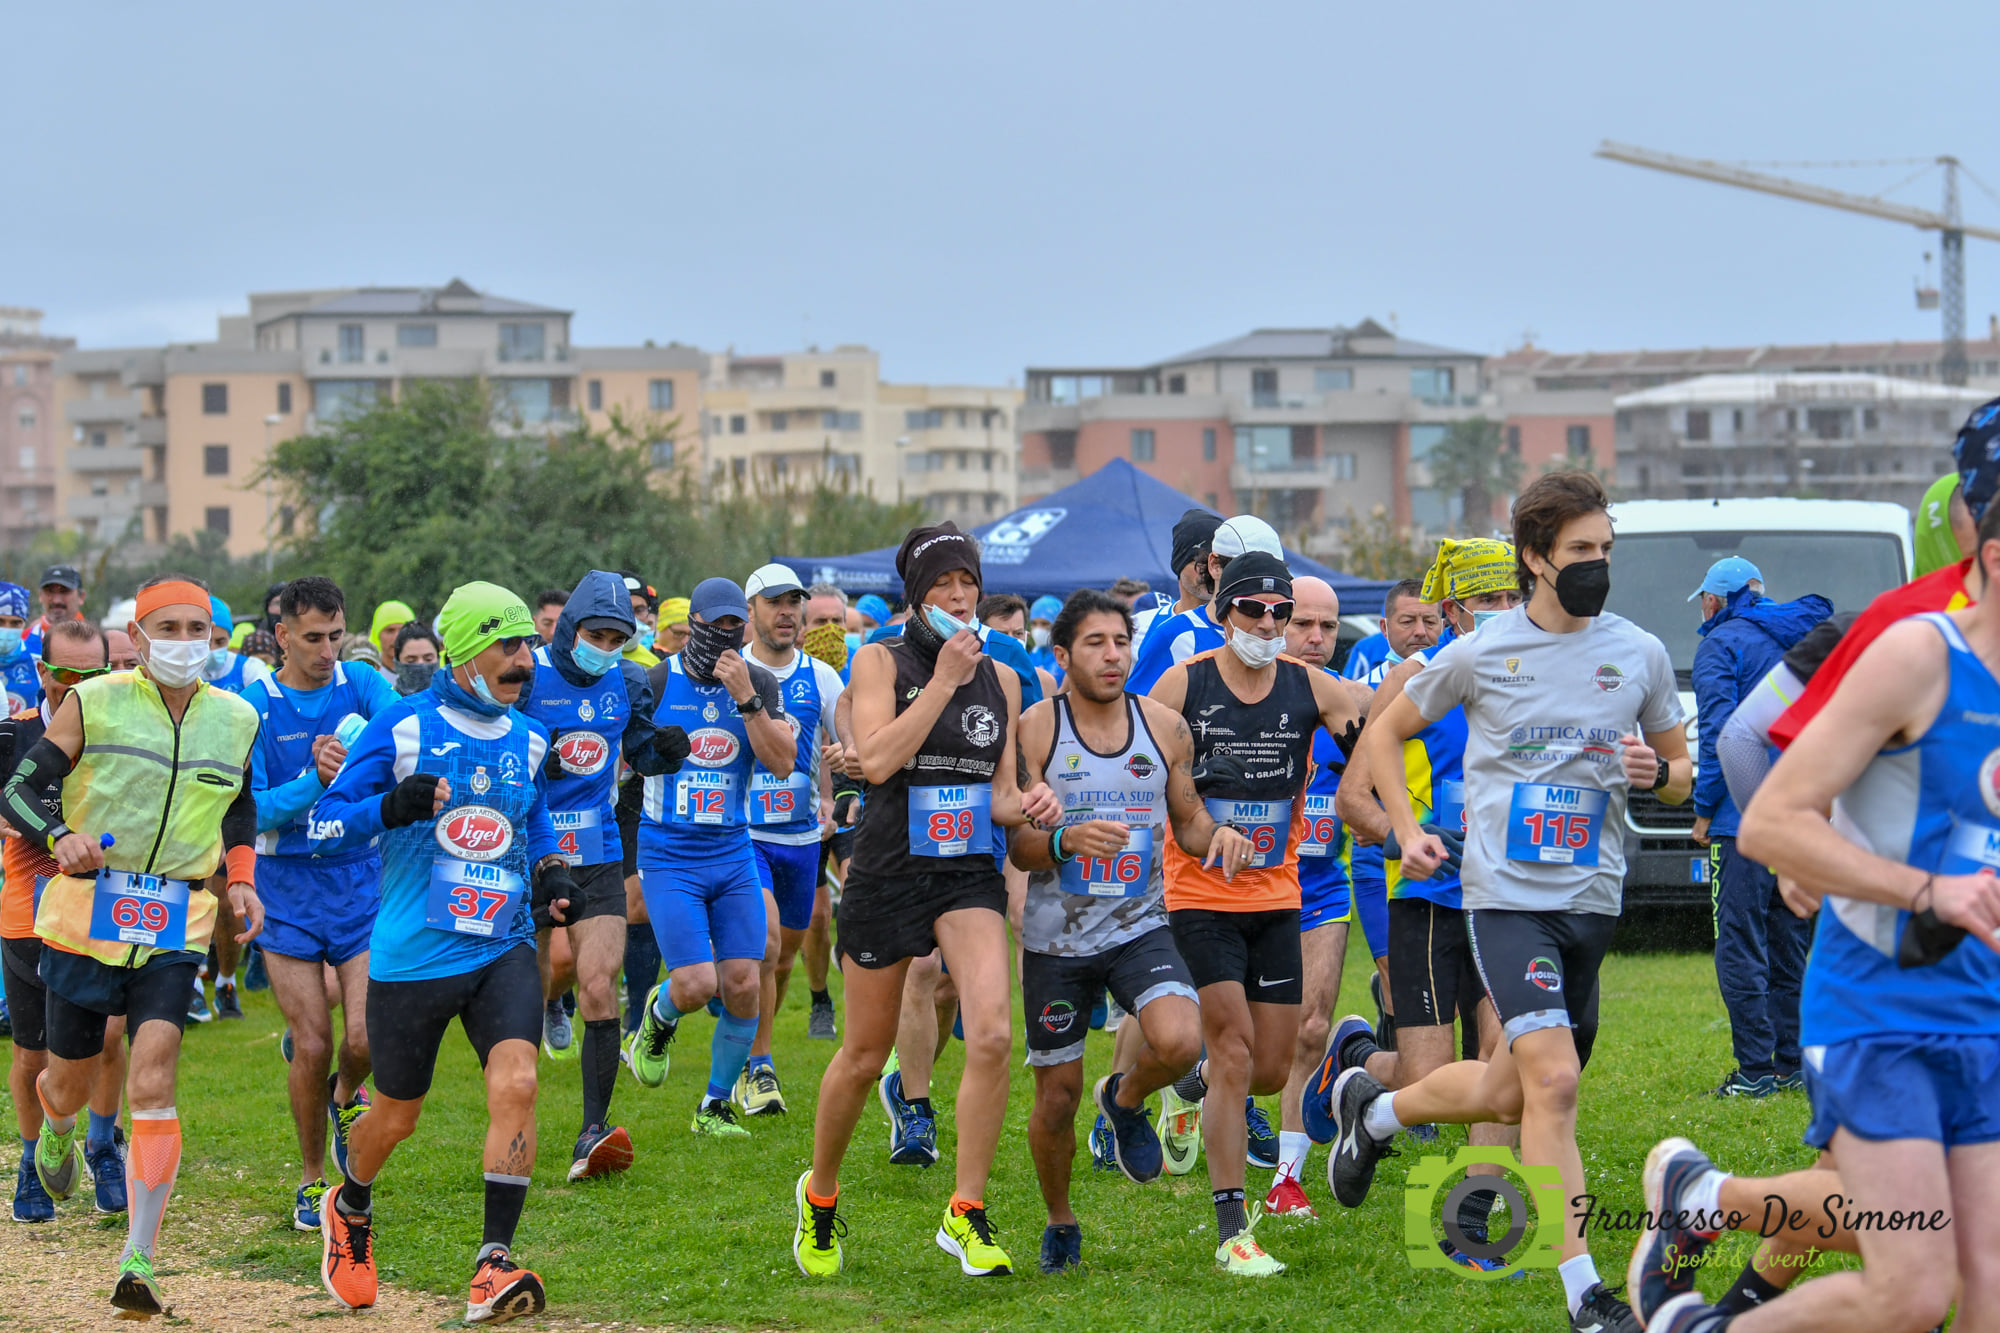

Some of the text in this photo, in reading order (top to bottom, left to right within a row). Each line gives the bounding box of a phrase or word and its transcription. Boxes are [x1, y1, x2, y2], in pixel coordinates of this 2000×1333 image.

[920, 535, 964, 550] GIVOVA
[276, 732, 308, 742] macron
[1530, 726, 1618, 742] ITTICA SUD
[562, 738, 602, 765] Sigel
[692, 734, 730, 758] Sigel
[918, 755, 996, 772] URBAN JUNGLE
[1512, 752, 1558, 761] MAZARA
[1124, 764, 1158, 772] EVOLUTION
[1256, 768, 1286, 778] GRANO
[690, 790, 725, 814] 12
[758, 790, 795, 814] 13
[1080, 791, 1154, 802] ITTICA SUD
[1546, 788, 1581, 804] MBI
[444, 808, 478, 824] GELATERIA
[1125, 813, 1150, 822] VALLO
[1234, 803, 1269, 816] MBI
[450, 814, 502, 848] Sigel
[928, 810, 974, 842] 88
[1524, 812, 1590, 849] 115
[558, 831, 580, 854] 4
[464, 863, 500, 882] MBI
[1075, 854, 1142, 883] 116
[1710, 844, 1722, 940] GIVOVA
[448, 886, 509, 922] 37
[112, 897, 169, 932] 69
